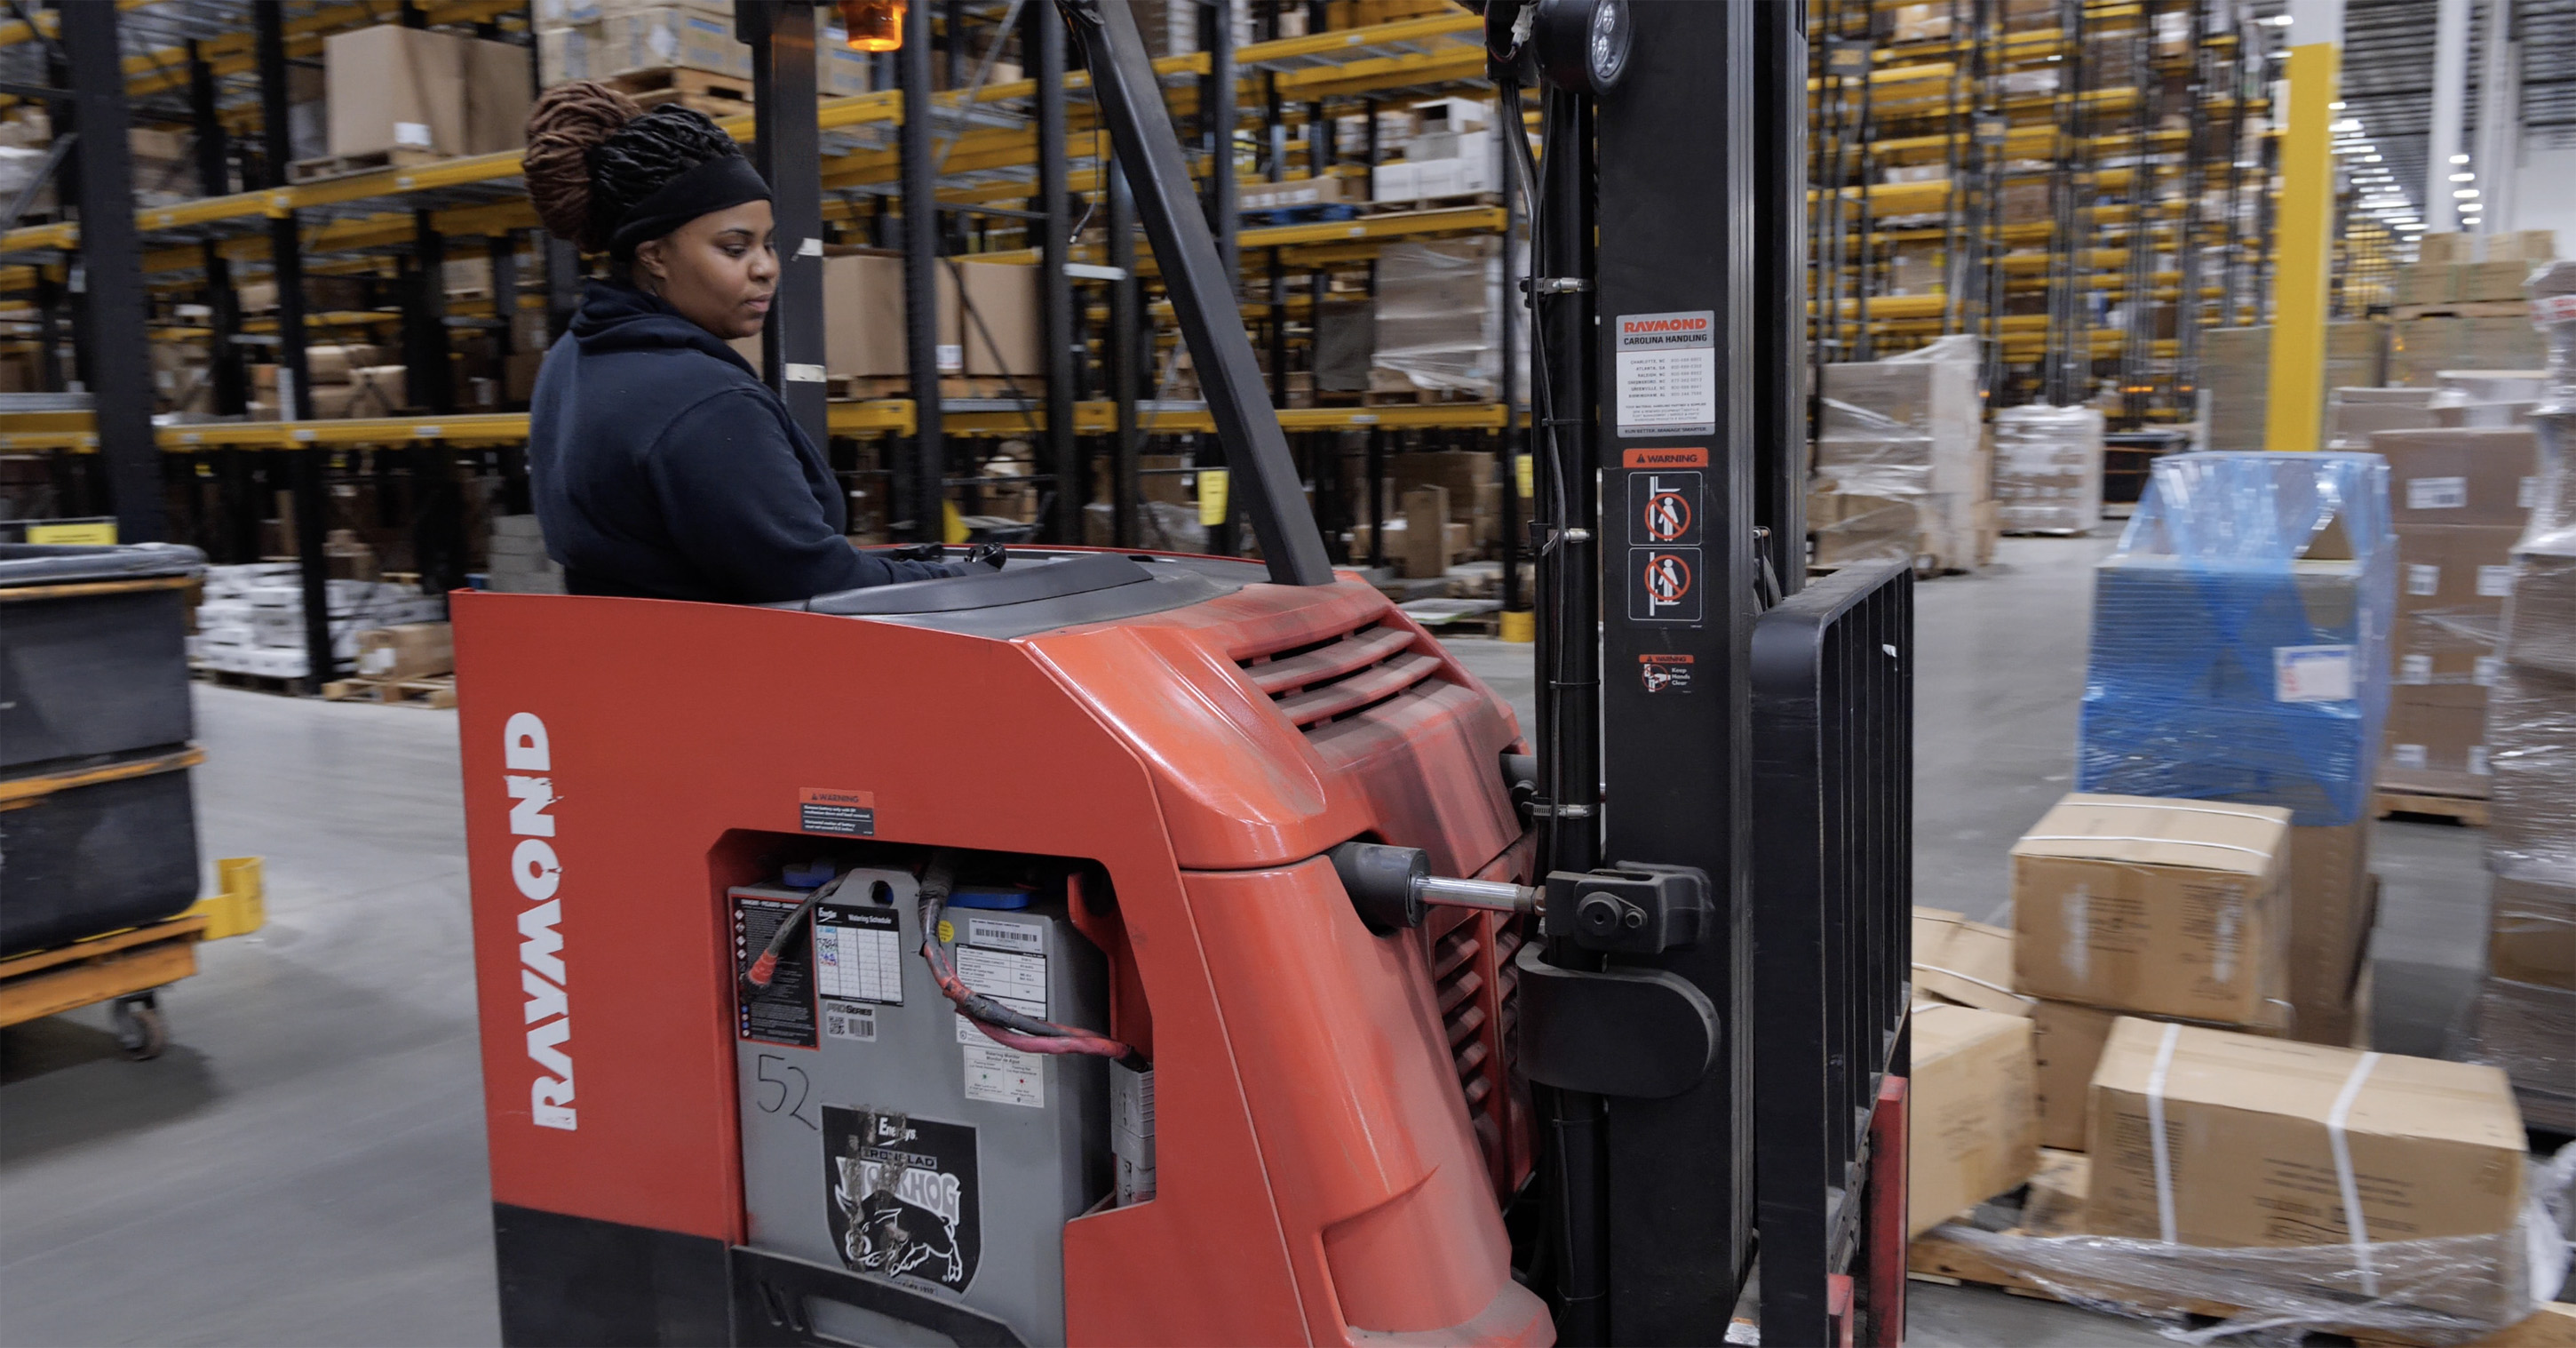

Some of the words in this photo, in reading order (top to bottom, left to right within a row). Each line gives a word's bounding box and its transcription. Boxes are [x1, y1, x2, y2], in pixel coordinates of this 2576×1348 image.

[1624, 318, 1707, 333] RAYMOND
[1624, 337, 1664, 346] CAROLINA
[1666, 334, 1707, 344] HANDLING
[819, 794, 859, 803] WARNING
[503, 711, 577, 1131] RAYMOND
[847, 913, 870, 924] Watering
[870, 915, 892, 924] Schedule
[757, 1054, 818, 1130] 52
